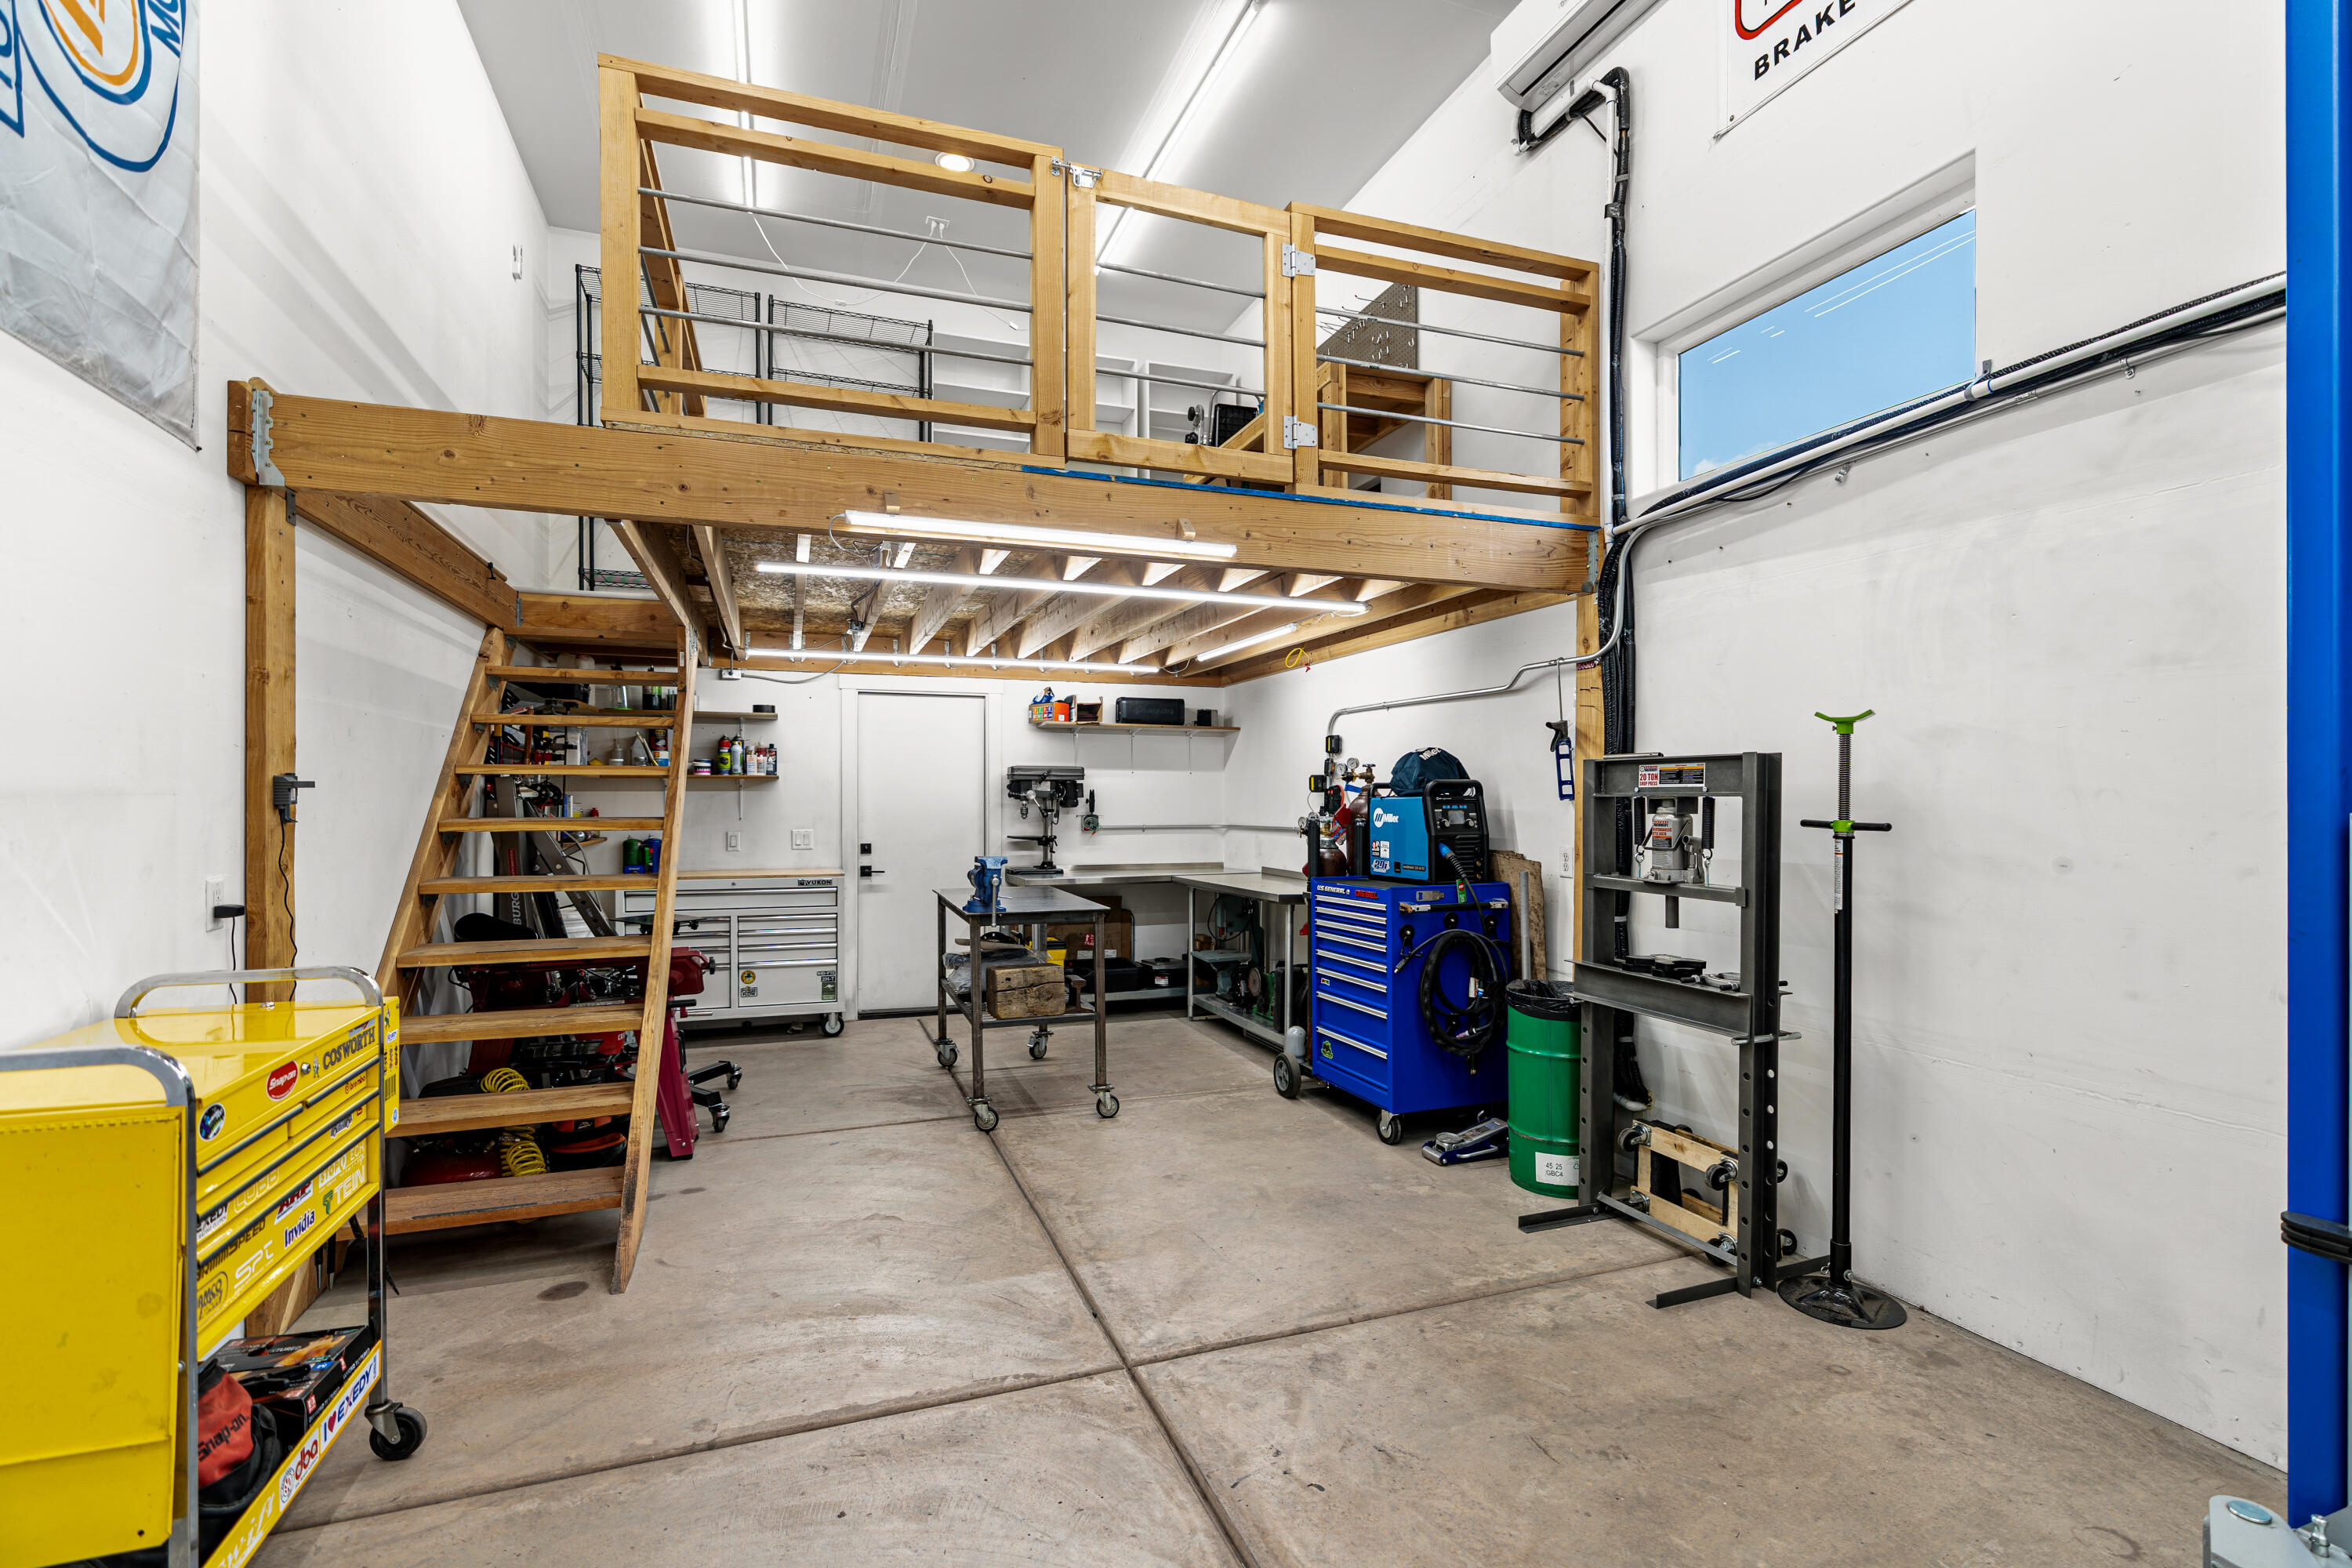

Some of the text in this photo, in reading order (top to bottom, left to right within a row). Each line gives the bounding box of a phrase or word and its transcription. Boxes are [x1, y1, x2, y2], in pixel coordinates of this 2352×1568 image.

[1754, 0, 1857, 82] BRAKE
[1419, 748, 1441, 760] Miller
[1384, 813, 1399, 823] Miller
[1355, 890, 1379, 899] DIESEL
[323, 1026, 376, 1070] COSWORTH
[269, 1069, 297, 1091] Snap-on
[334, 1165, 365, 1205] TEIN
[284, 1208, 316, 1250] Invidia
[323, 1362, 375, 1443] I EXEDY
[198, 1413, 247, 1462] Snap-on
[295, 1439, 319, 1481] dba
